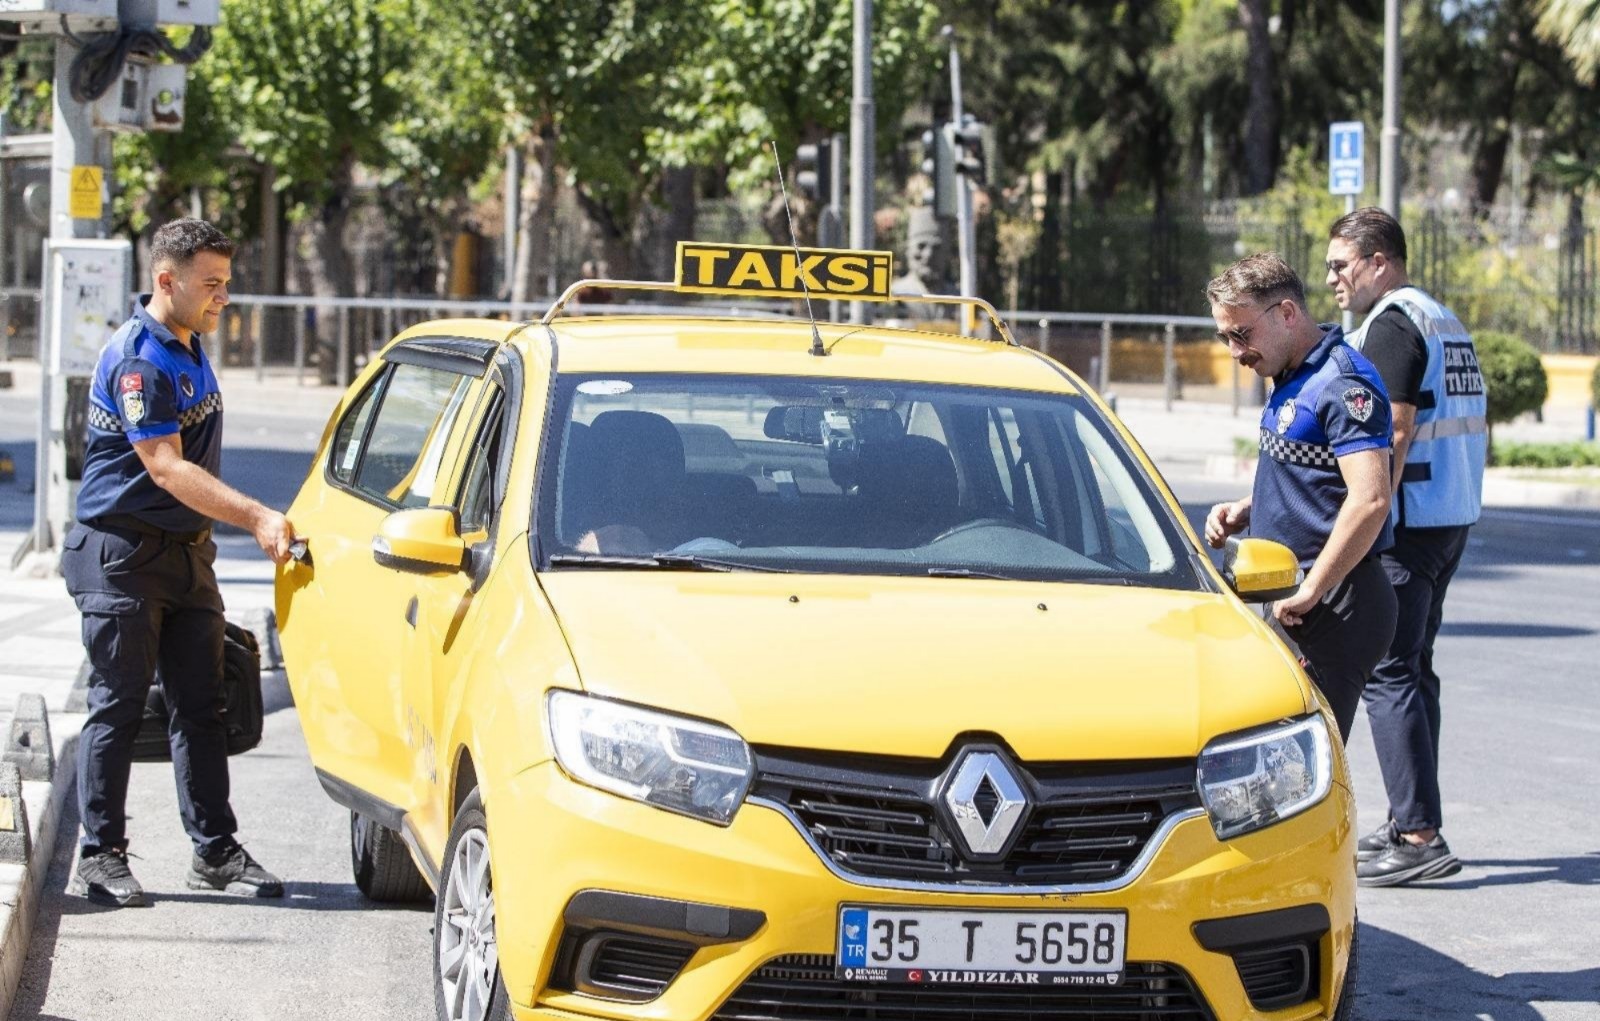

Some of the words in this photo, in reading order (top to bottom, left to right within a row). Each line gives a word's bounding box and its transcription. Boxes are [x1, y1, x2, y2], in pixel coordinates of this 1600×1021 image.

[1445, 367, 1482, 393] TFİK
[871, 918, 920, 962] 35
[962, 921, 983, 963] T
[1015, 922, 1116, 965] 5658
[846, 944, 865, 957] TR
[855, 968, 889, 976] RENAULT
[928, 970, 1040, 984] YILDIZLAR
[1086, 976, 1095, 985] 12
